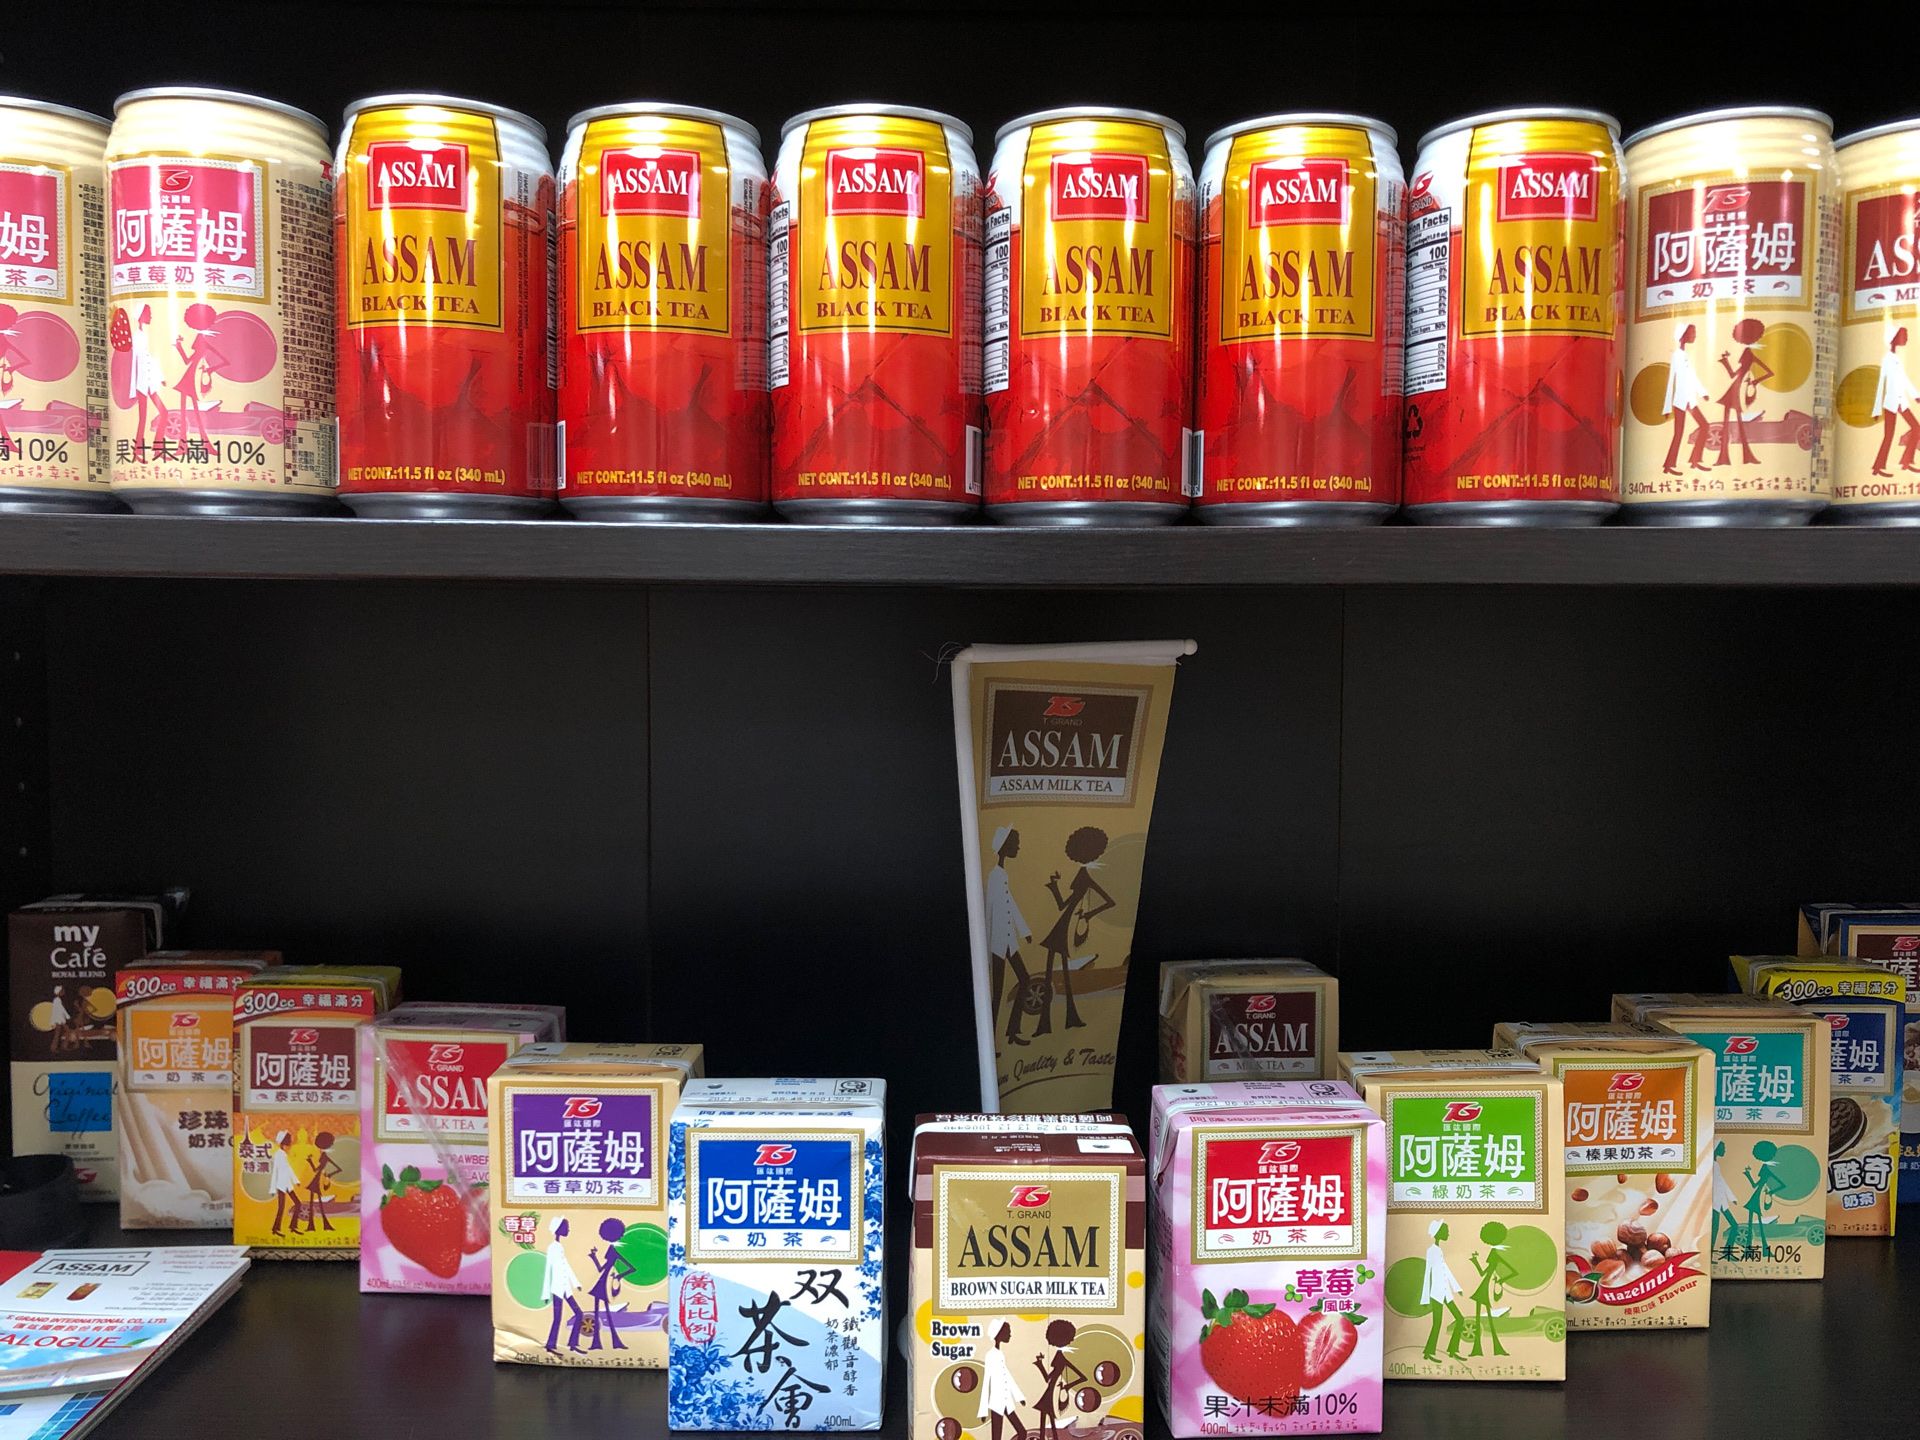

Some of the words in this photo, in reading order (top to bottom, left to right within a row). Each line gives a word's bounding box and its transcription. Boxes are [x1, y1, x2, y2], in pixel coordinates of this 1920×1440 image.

[378, 162, 455, 188] ASSAM
[612, 168, 688, 195] ASSAM
[837, 168, 916, 194] ASSAM
[1063, 173, 1138, 199] ASSAM
[1261, 178, 1337, 206] ASSAM
[1511, 172, 1589, 199] ASSAM
[990, 212, 1009, 228] Facts
[1422, 213, 1449, 229] Facts
[116, 205, 247, 262] 阿薩姆
[777, 239, 788, 254] 100
[995, 244, 1008, 260] 100
[1429, 245, 1447, 260] 100
[1654, 222, 1796, 280] 阿薩姆
[363, 235, 477, 287] ASSAM
[819, 241, 930, 292] ASSAM
[1864, 233, 1920, 281] AS
[127, 265, 226, 286] 草莓奶茶
[595, 241, 708, 293] ASSAM
[1042, 246, 1153, 296] ASSAM
[1241, 251, 1354, 301] ASSAM
[1488, 245, 1601, 295] ASSAM
[5, 268, 28, 287] 茶
[362, 296, 427, 312] BLACK
[436, 297, 480, 314] TEA
[593, 301, 662, 317] BLACK
[667, 302, 710, 320] TEA
[817, 301, 886, 319] BLACK
[892, 302, 932, 320] TEA
[1040, 305, 1112, 322] BLACK
[1117, 306, 1155, 323] TEA
[1485, 305, 1560, 322] BLACK
[1566, 306, 1600, 322] TEA
[1239, 310, 1309, 328] BLACK
[1315, 309, 1355, 325] TEA
[115, 438, 266, 466] 果汁未滿10%
[348, 468, 362, 480] NET
[424, 467, 434, 480] fl
[437, 471, 452, 480] oz
[455, 468, 481, 483] (340
[484, 470, 505, 485] mL)
[577, 472, 593, 485] NET
[657, 471, 667, 484] fl
[670, 475, 684, 485] oz
[687, 472, 711, 487] (340
[714, 474, 732, 489] mL)
[799, 473, 817, 485] NET
[882, 472, 890, 485] fl
[894, 476, 906, 485] oz
[910, 473, 932, 488] (340
[935, 475, 951, 490] mL)
[1018, 477, 1037, 489] NET
[1104, 475, 1113, 487] fl
[1117, 478, 1129, 488] oz
[1132, 475, 1152, 491] (340
[1155, 477, 1170, 492] mL)
[1217, 478, 1234, 492] NET
[1300, 477, 1309, 488] fl
[1313, 479, 1326, 489] oz
[1329, 476, 1352, 492] (340
[1355, 478, 1372, 493] mL)
[1457, 476, 1480, 488] NET
[1552, 474, 1561, 487] fl
[1564, 478, 1576, 487] oz
[1579, 475, 1597, 490] (340
[1599, 477, 1612, 491] mL)
[1628, 482, 1657, 495] 340mL
[1836, 486, 1857, 498] NET
[998, 730, 1123, 769] ASSAM
[1000, 779, 1043, 791] ASSAM
[1048, 780, 1082, 791] MILK
[1087, 781, 1113, 792] TEA
[53, 925, 100, 945] my
[126, 977, 177, 998] 300cc
[1782, 981, 1832, 1001] 300cc
[1838, 981, 1898, 995] 幸福滿分
[243, 993, 295, 1014] 300cc
[302, 993, 364, 1008] 幸福滿分
[1215, 1023, 1308, 1053] ASSAM
[137, 1037, 231, 1069] 阿薩姆
[256, 1053, 351, 1088] 阿薩姆
[1013, 1055, 1058, 1081] Quality
[1063, 1049, 1075, 1066] &
[1079, 1048, 1116, 1066] Taste
[1266, 1060, 1284, 1070] TEA
[166, 1072, 204, 1082] 奶茶
[1715, 1064, 1794, 1103] 薩姆
[1838, 1074, 1852, 1084] 茶
[275, 1092, 333, 1102] 泰式奶茶
[179, 1111, 229, 1130] 珍珠
[1567, 1099, 1676, 1143] 阿薩姆
[1717, 1108, 1761, 1121] 奶茶
[452, 1119, 475, 1130] TEA
[189, 1134, 225, 1149] 奶茶
[520, 1128, 645, 1175] 阿薩姆
[1400, 1133, 1525, 1178] 阿薩姆
[1586, 1147, 1653, 1162] 榛果奶茶
[1828, 1154, 1892, 1192] 酷奇
[543, 1180, 624, 1194] 香草奶茶
[1432, 1184, 1495, 1199] 綠奶茶
[707, 1177, 842, 1226] 阿薩姆
[1213, 1175, 1345, 1225] 阿薩姆
[1842, 1193, 1874, 1208] 奶茶
[505, 1216, 536, 1232] 香草
[1018, 1211, 1051, 1219] GRAND
[514, 1233, 536, 1243] 口味
[747, 1233, 803, 1247] 奶茶
[958, 1225, 1099, 1268] ASSAM
[1253, 1229, 1308, 1245] 奶茶
[1712, 1245, 1801, 1263] 未滿10%
[52, 1262, 134, 1273] ASSAM
[951, 1281, 997, 1296] BROWN
[1001, 1281, 1042, 1295] SUGAR
[1046, 1281, 1078, 1295] MILK
[1081, 1282, 1105, 1295] TEA
[1296, 1269, 1354, 1297] 草莓
[1603, 1262, 1675, 1302] Hazelnut
[1658, 1279, 1698, 1305] Flavour
[687, 1274, 713, 1335] 黃金比例
[1324, 1300, 1353, 1312] 風味
[1624, 1300, 1655, 1315] 榛果口味
[52, 1316, 125, 1324] INTERNATIONAL
[932, 1322, 980, 1336] Brown
[824, 1318, 839, 1371] 奶茶濃郁
[932, 1342, 973, 1360] Sugar
[1388, 1363, 1419, 1375] 400mL
[1204, 1393, 1357, 1418] 果汁未滿10%
[824, 1415, 856, 1427] 400mL
[1201, 1423, 1232, 1434] 400mL
